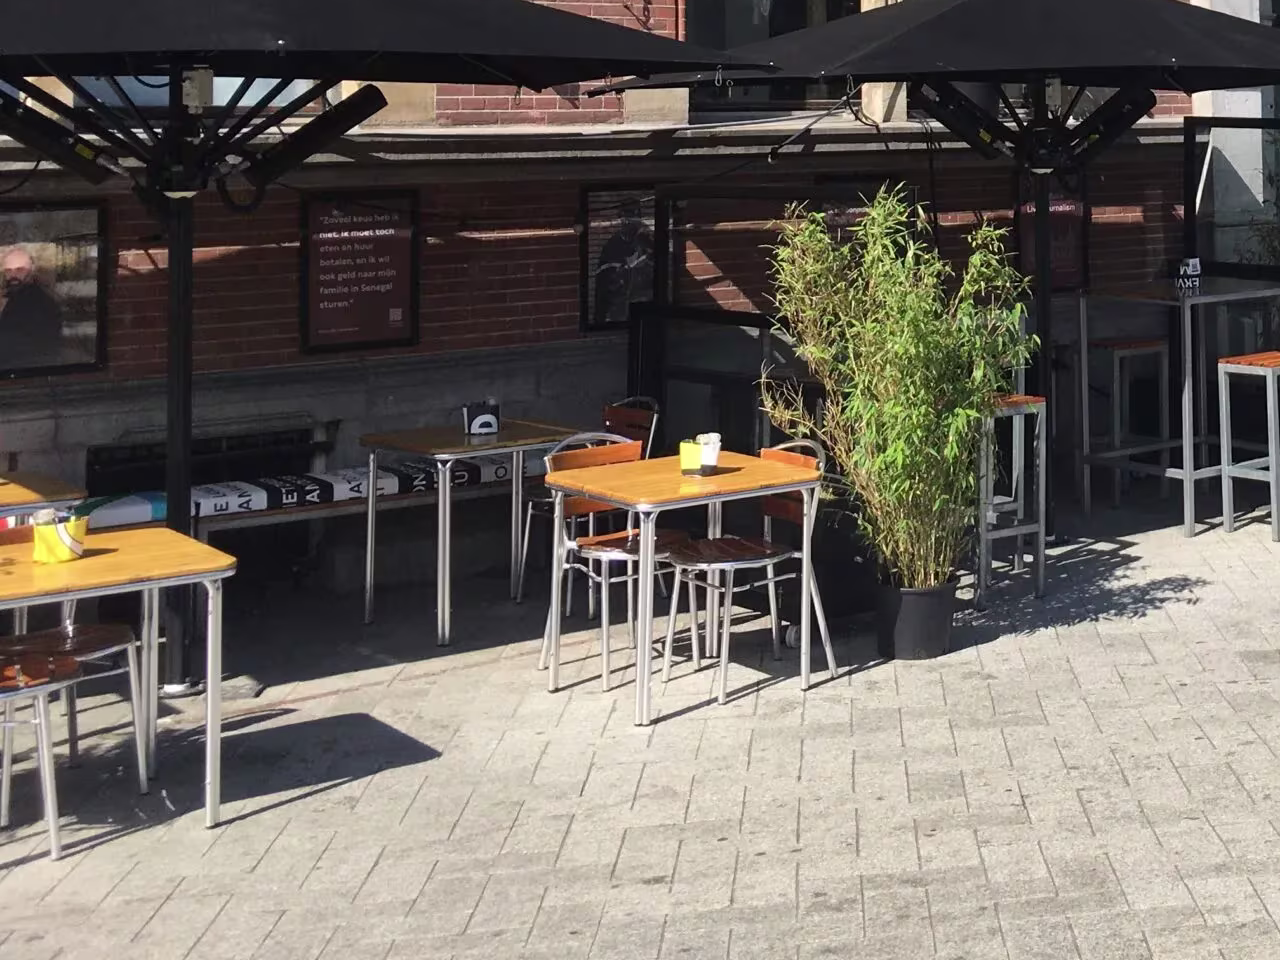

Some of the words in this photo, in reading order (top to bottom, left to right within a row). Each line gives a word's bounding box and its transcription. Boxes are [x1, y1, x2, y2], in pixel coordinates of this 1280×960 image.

[350, 228, 374, 237] moet
[375, 227, 395, 236] toch
[319, 244, 340, 253] eten
[341, 244, 352, 252] en
[353, 242, 374, 251] huur
[319, 257, 354, 267] betalen,
[355, 256, 367, 264] en
[368, 255, 377, 264] ik
[378, 255, 390, 263] wil
[319, 272, 336, 281] ook
[337, 270, 356, 281] geld
[357, 270, 376, 279] naar
[377, 268, 397, 279] mijn
[319, 285, 349, 295] familie
[350, 284, 359, 293] in
[360, 282, 393, 294] Senegal
